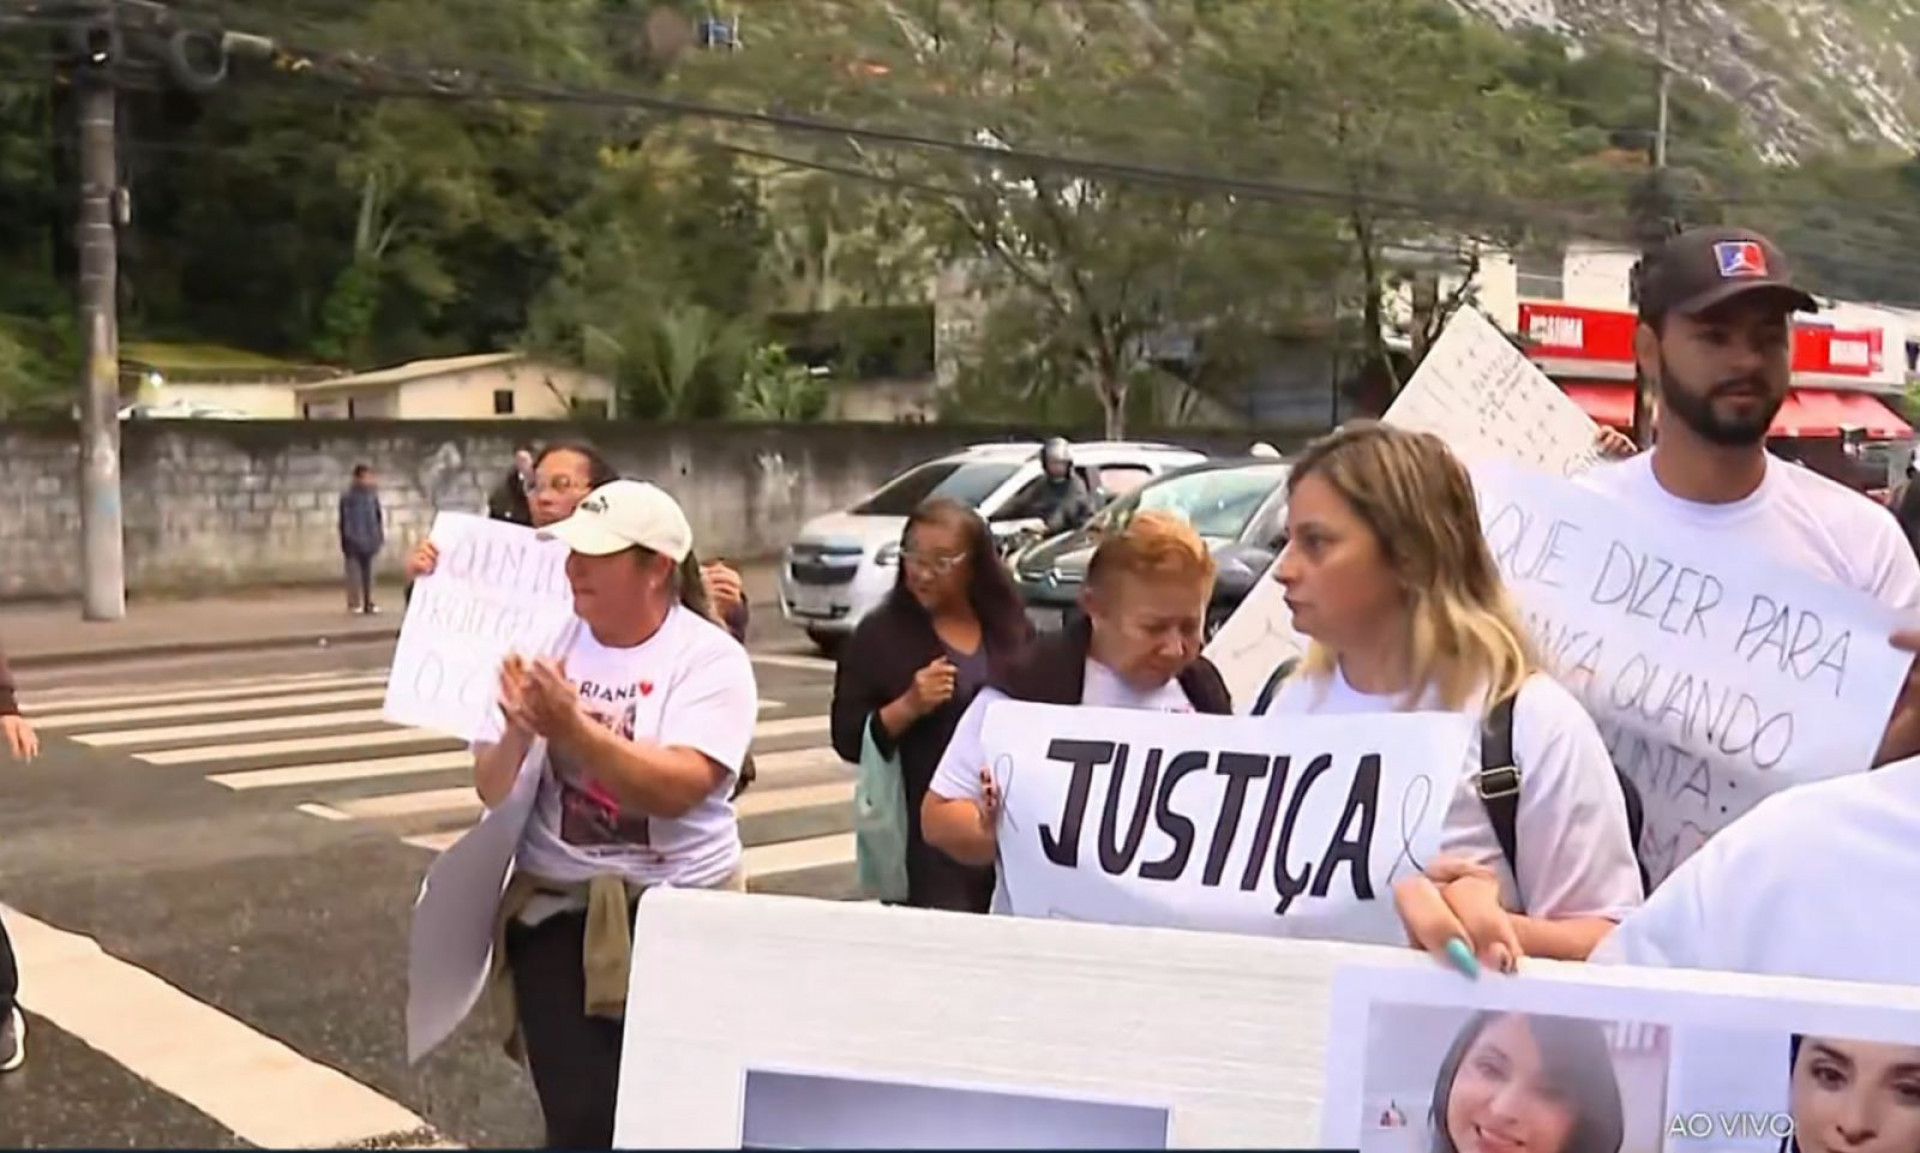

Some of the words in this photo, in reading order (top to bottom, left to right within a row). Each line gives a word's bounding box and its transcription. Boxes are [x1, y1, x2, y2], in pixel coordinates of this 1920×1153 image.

[1485, 503, 1581, 589] QUE
[1590, 539, 1724, 639] DIZER
[1733, 594, 1852, 698] PARA
[576, 680, 637, 703] RIANE
[1610, 652, 1795, 770] QUANDO
[1039, 738, 1381, 914] JUSTIÇA
